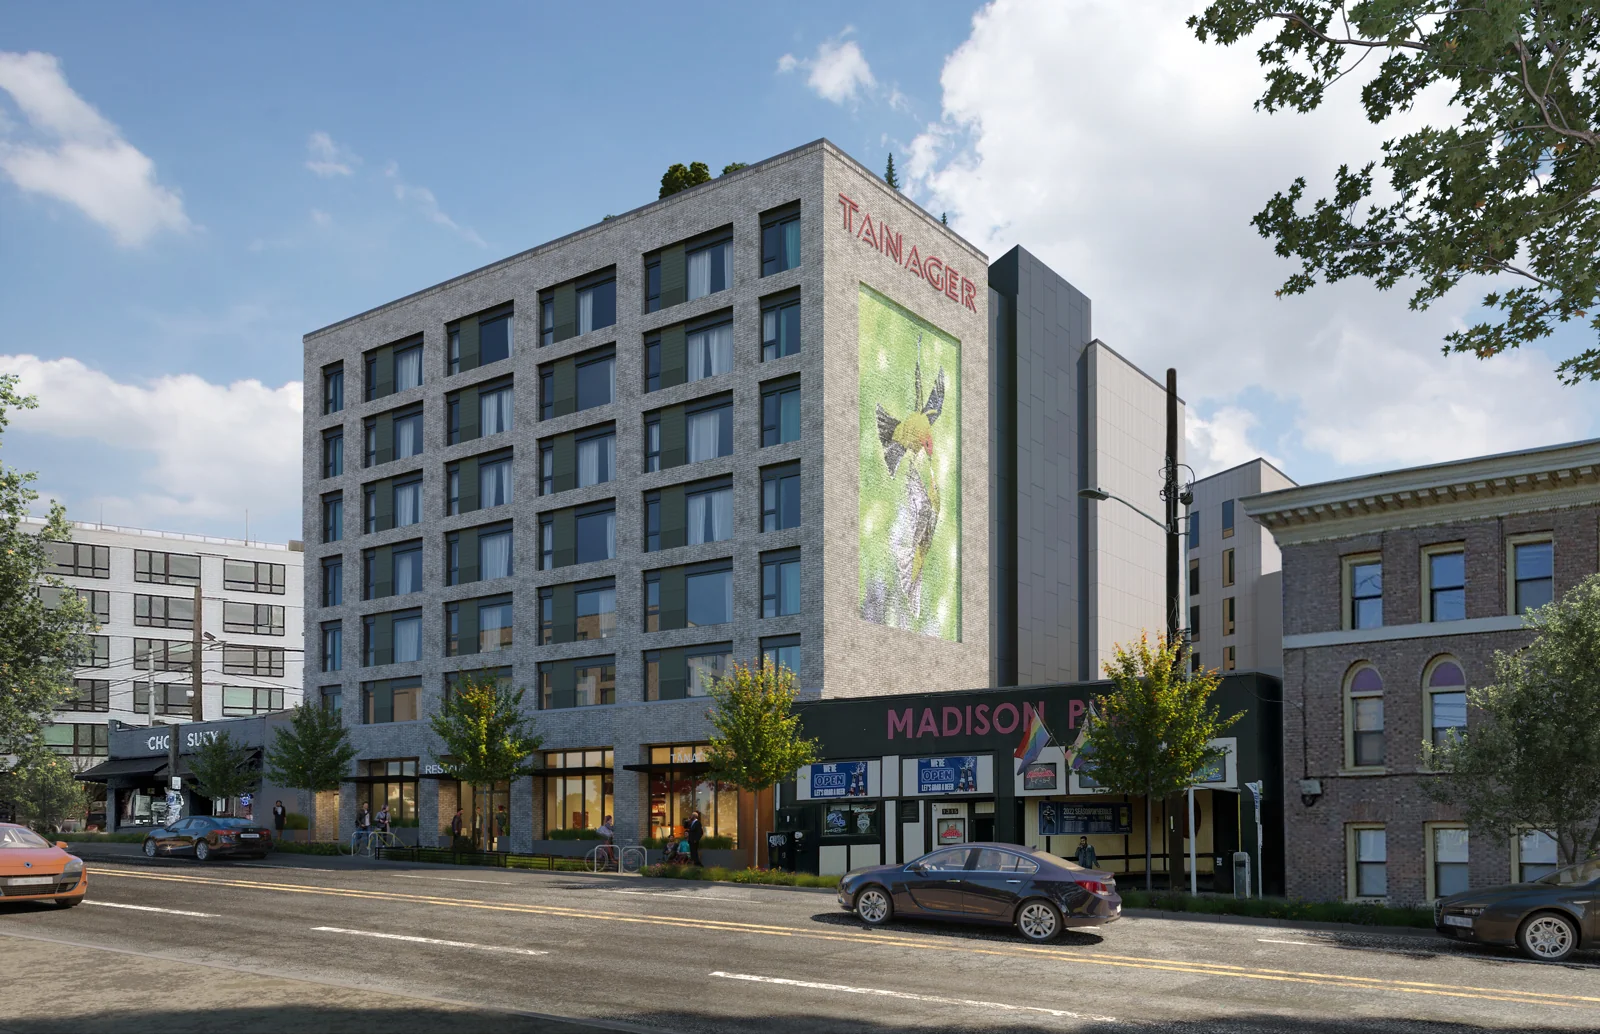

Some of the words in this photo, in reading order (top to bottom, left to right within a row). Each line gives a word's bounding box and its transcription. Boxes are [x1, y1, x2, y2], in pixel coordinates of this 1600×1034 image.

[838, 192, 977, 313] TANAGER
[887, 700, 1045, 740] MADISON
[147, 734, 170, 750] CHO
[816, 774, 845, 787] OPEN
[923, 769, 953, 782] OPEN
[814, 789, 823, 797] LET'S
[921, 784, 931, 792] LET'S
[1063, 807, 1074, 815] 2022
